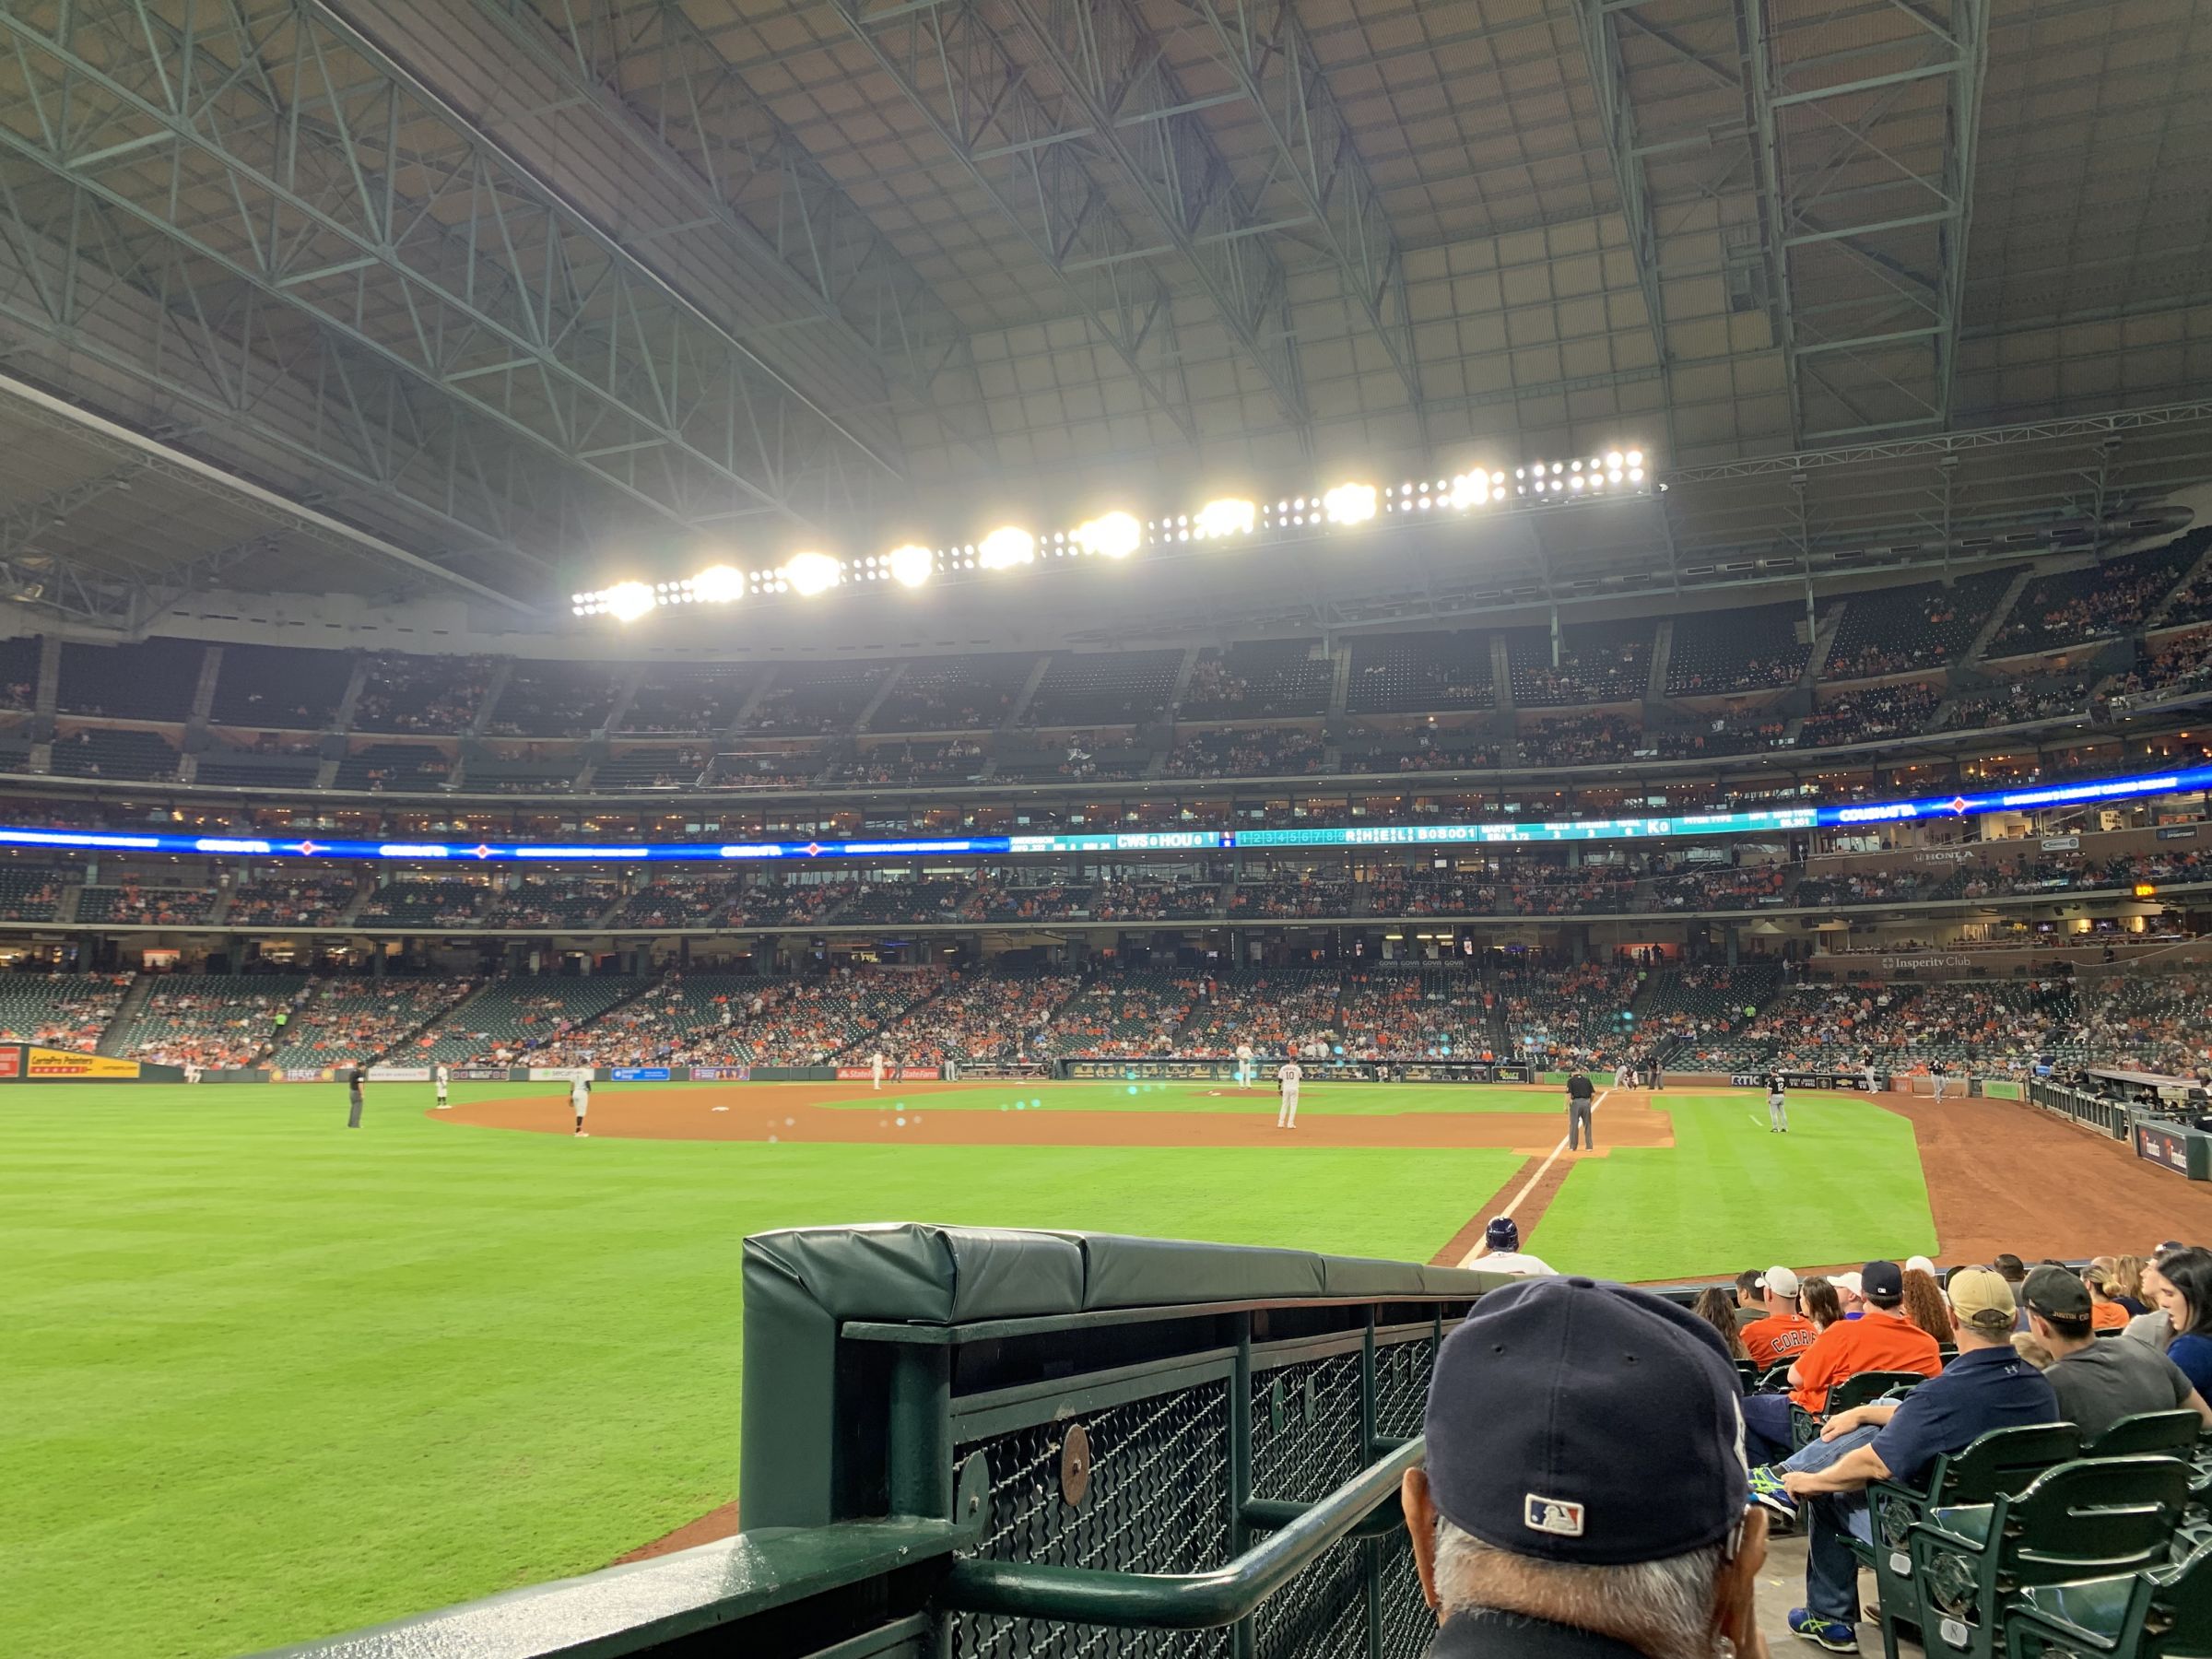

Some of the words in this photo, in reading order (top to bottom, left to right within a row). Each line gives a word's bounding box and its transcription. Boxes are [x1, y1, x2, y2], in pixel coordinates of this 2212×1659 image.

[1117, 834, 1148, 847] CWS
[1159, 834, 1192, 847] HOU
[1946, 955, 1971, 966] Club
[1286, 1071, 1294, 1080] 10
[1731, 1075, 1759, 1086] RTIC
[1777, 1082, 1784, 1092] 12
[1771, 1330, 1818, 1354] CORRE
[1950, 1624, 1959, 1639] 8
